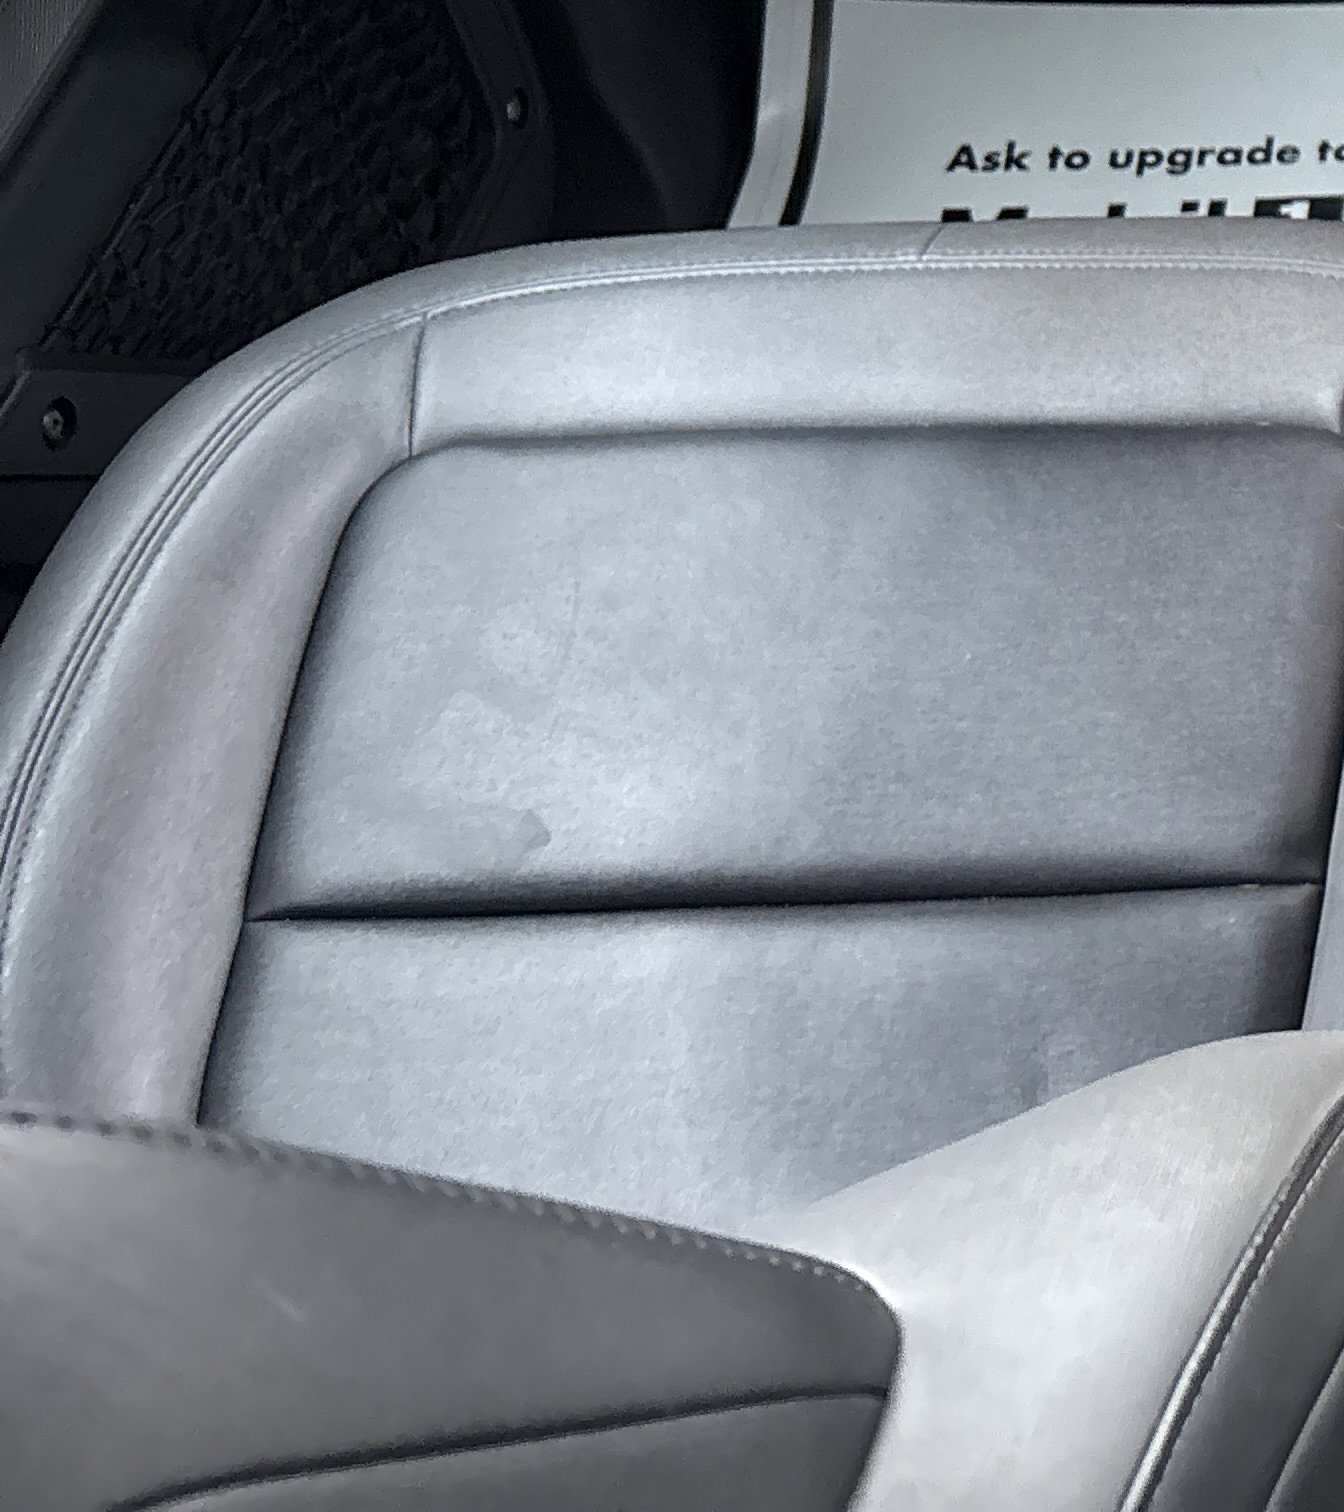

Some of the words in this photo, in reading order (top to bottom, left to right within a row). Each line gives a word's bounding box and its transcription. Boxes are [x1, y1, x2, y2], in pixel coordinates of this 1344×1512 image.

[946, 141, 1030, 173] Ask
[1048, 145, 1090, 171] to
[1109, 135, 1302, 177] upgrade
